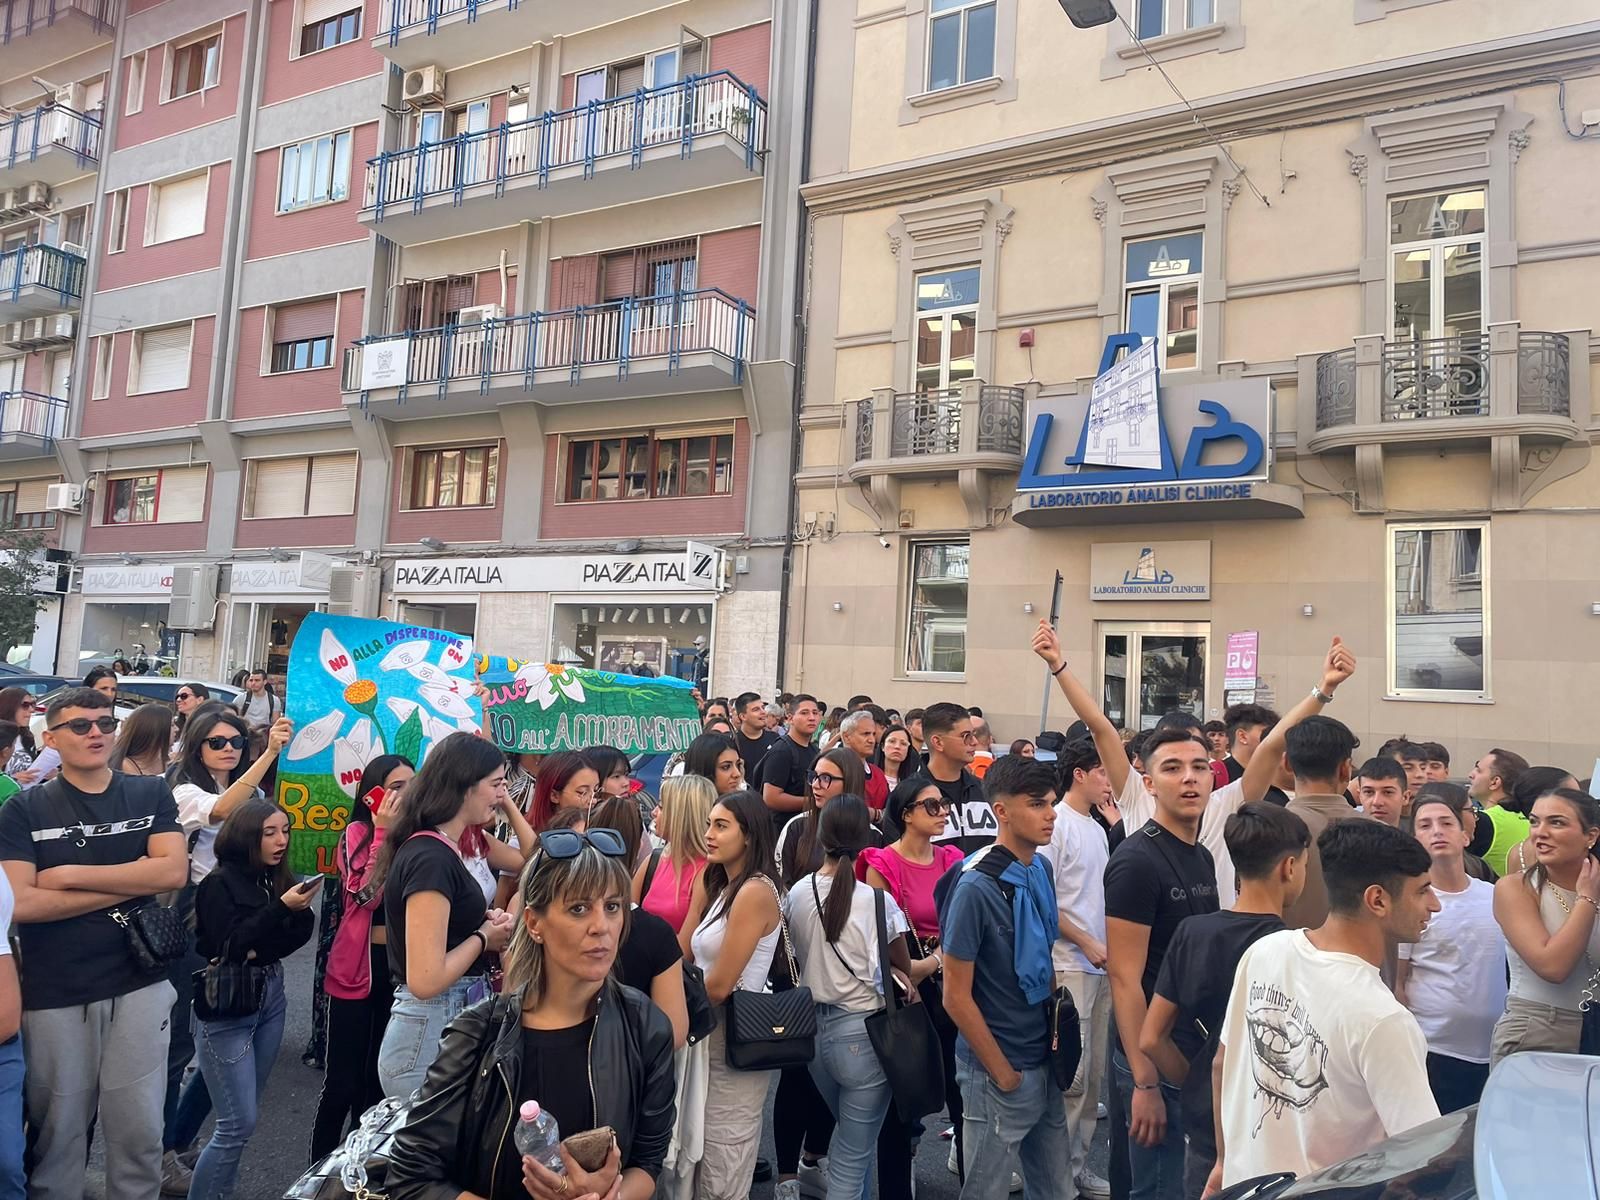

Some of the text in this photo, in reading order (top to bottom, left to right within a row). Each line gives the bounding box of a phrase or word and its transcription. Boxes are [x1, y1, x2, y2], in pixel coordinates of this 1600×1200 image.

[1030, 483, 1252, 508] LABORATORIO ANALISI CLINICHE
[454, 565, 503, 585] ITALIA
[653, 561, 687, 583] ITAL
[1093, 585, 1206, 594] LABORATORIO ANALISI CLINICHE
[329, 627, 464, 672] NO ALLA DISPERSIONE
[550, 712, 703, 751] ACCORPAMENTO
[279, 780, 350, 831] Res
